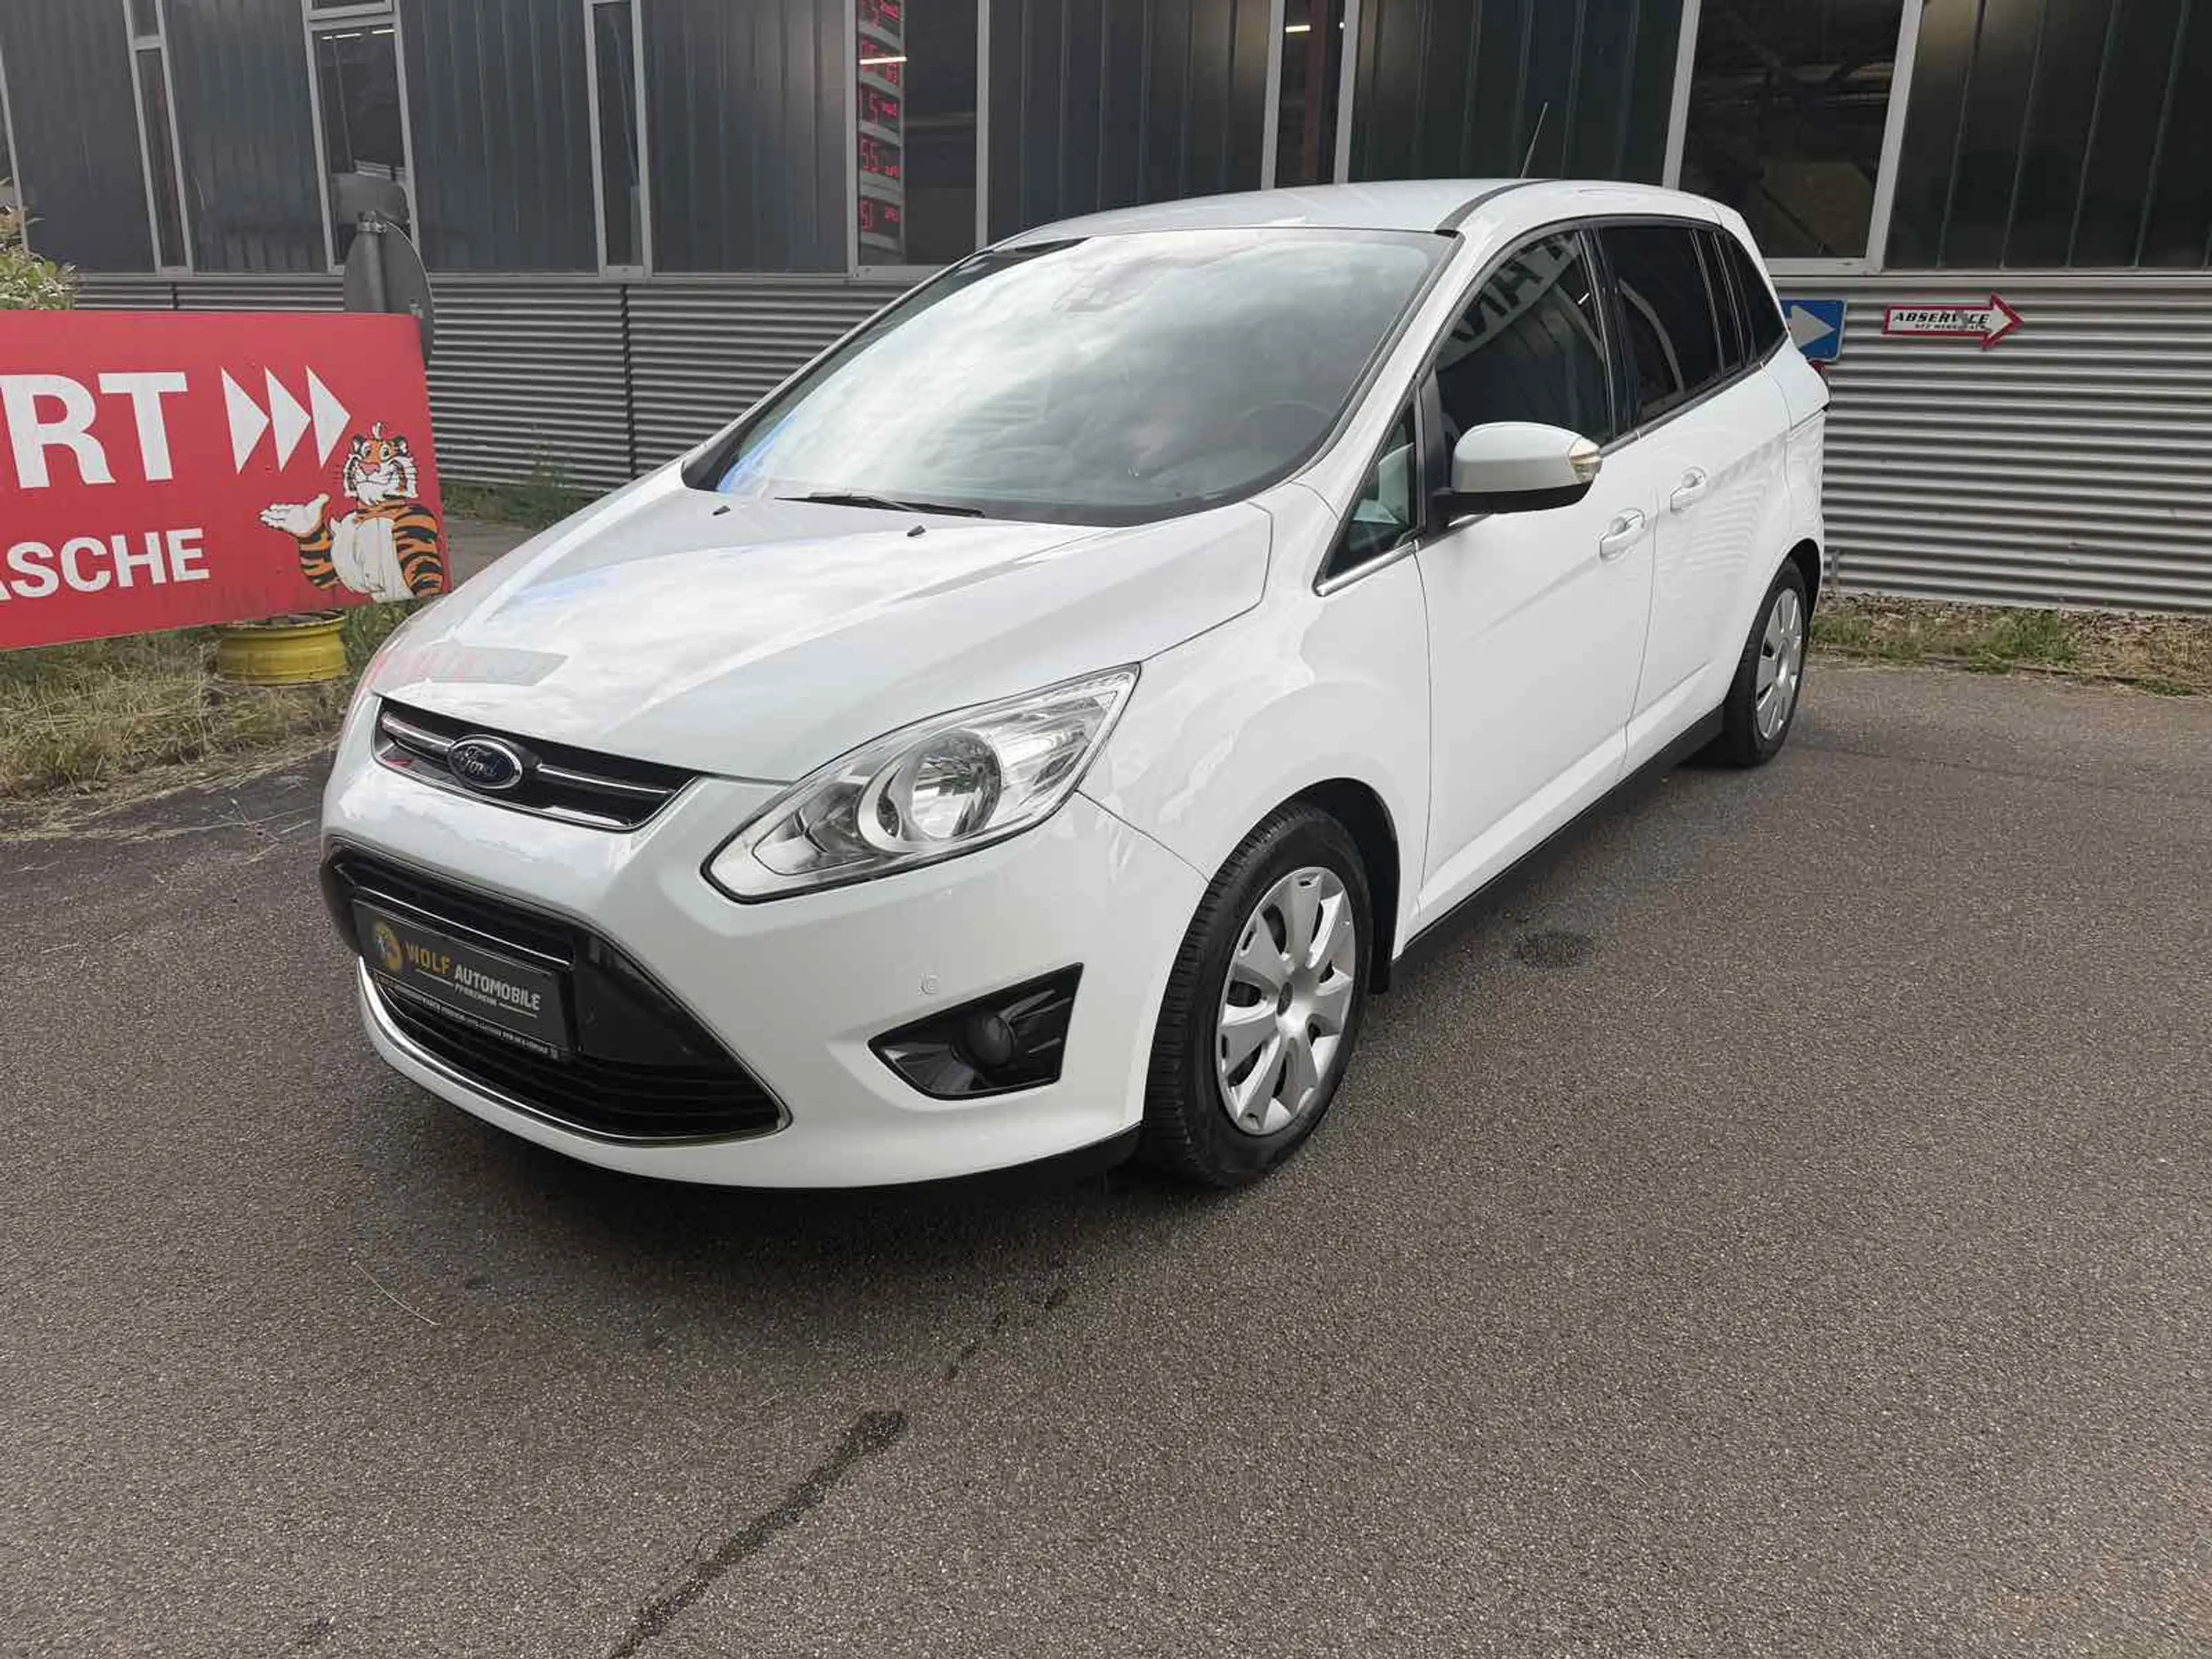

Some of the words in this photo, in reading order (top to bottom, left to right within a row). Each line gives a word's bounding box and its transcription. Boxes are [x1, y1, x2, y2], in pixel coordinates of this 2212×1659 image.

[0, 528, 210, 600] SCHE
[404, 940, 450, 974] WOLF
[454, 964, 541, 1011] AUTOMOBILE
